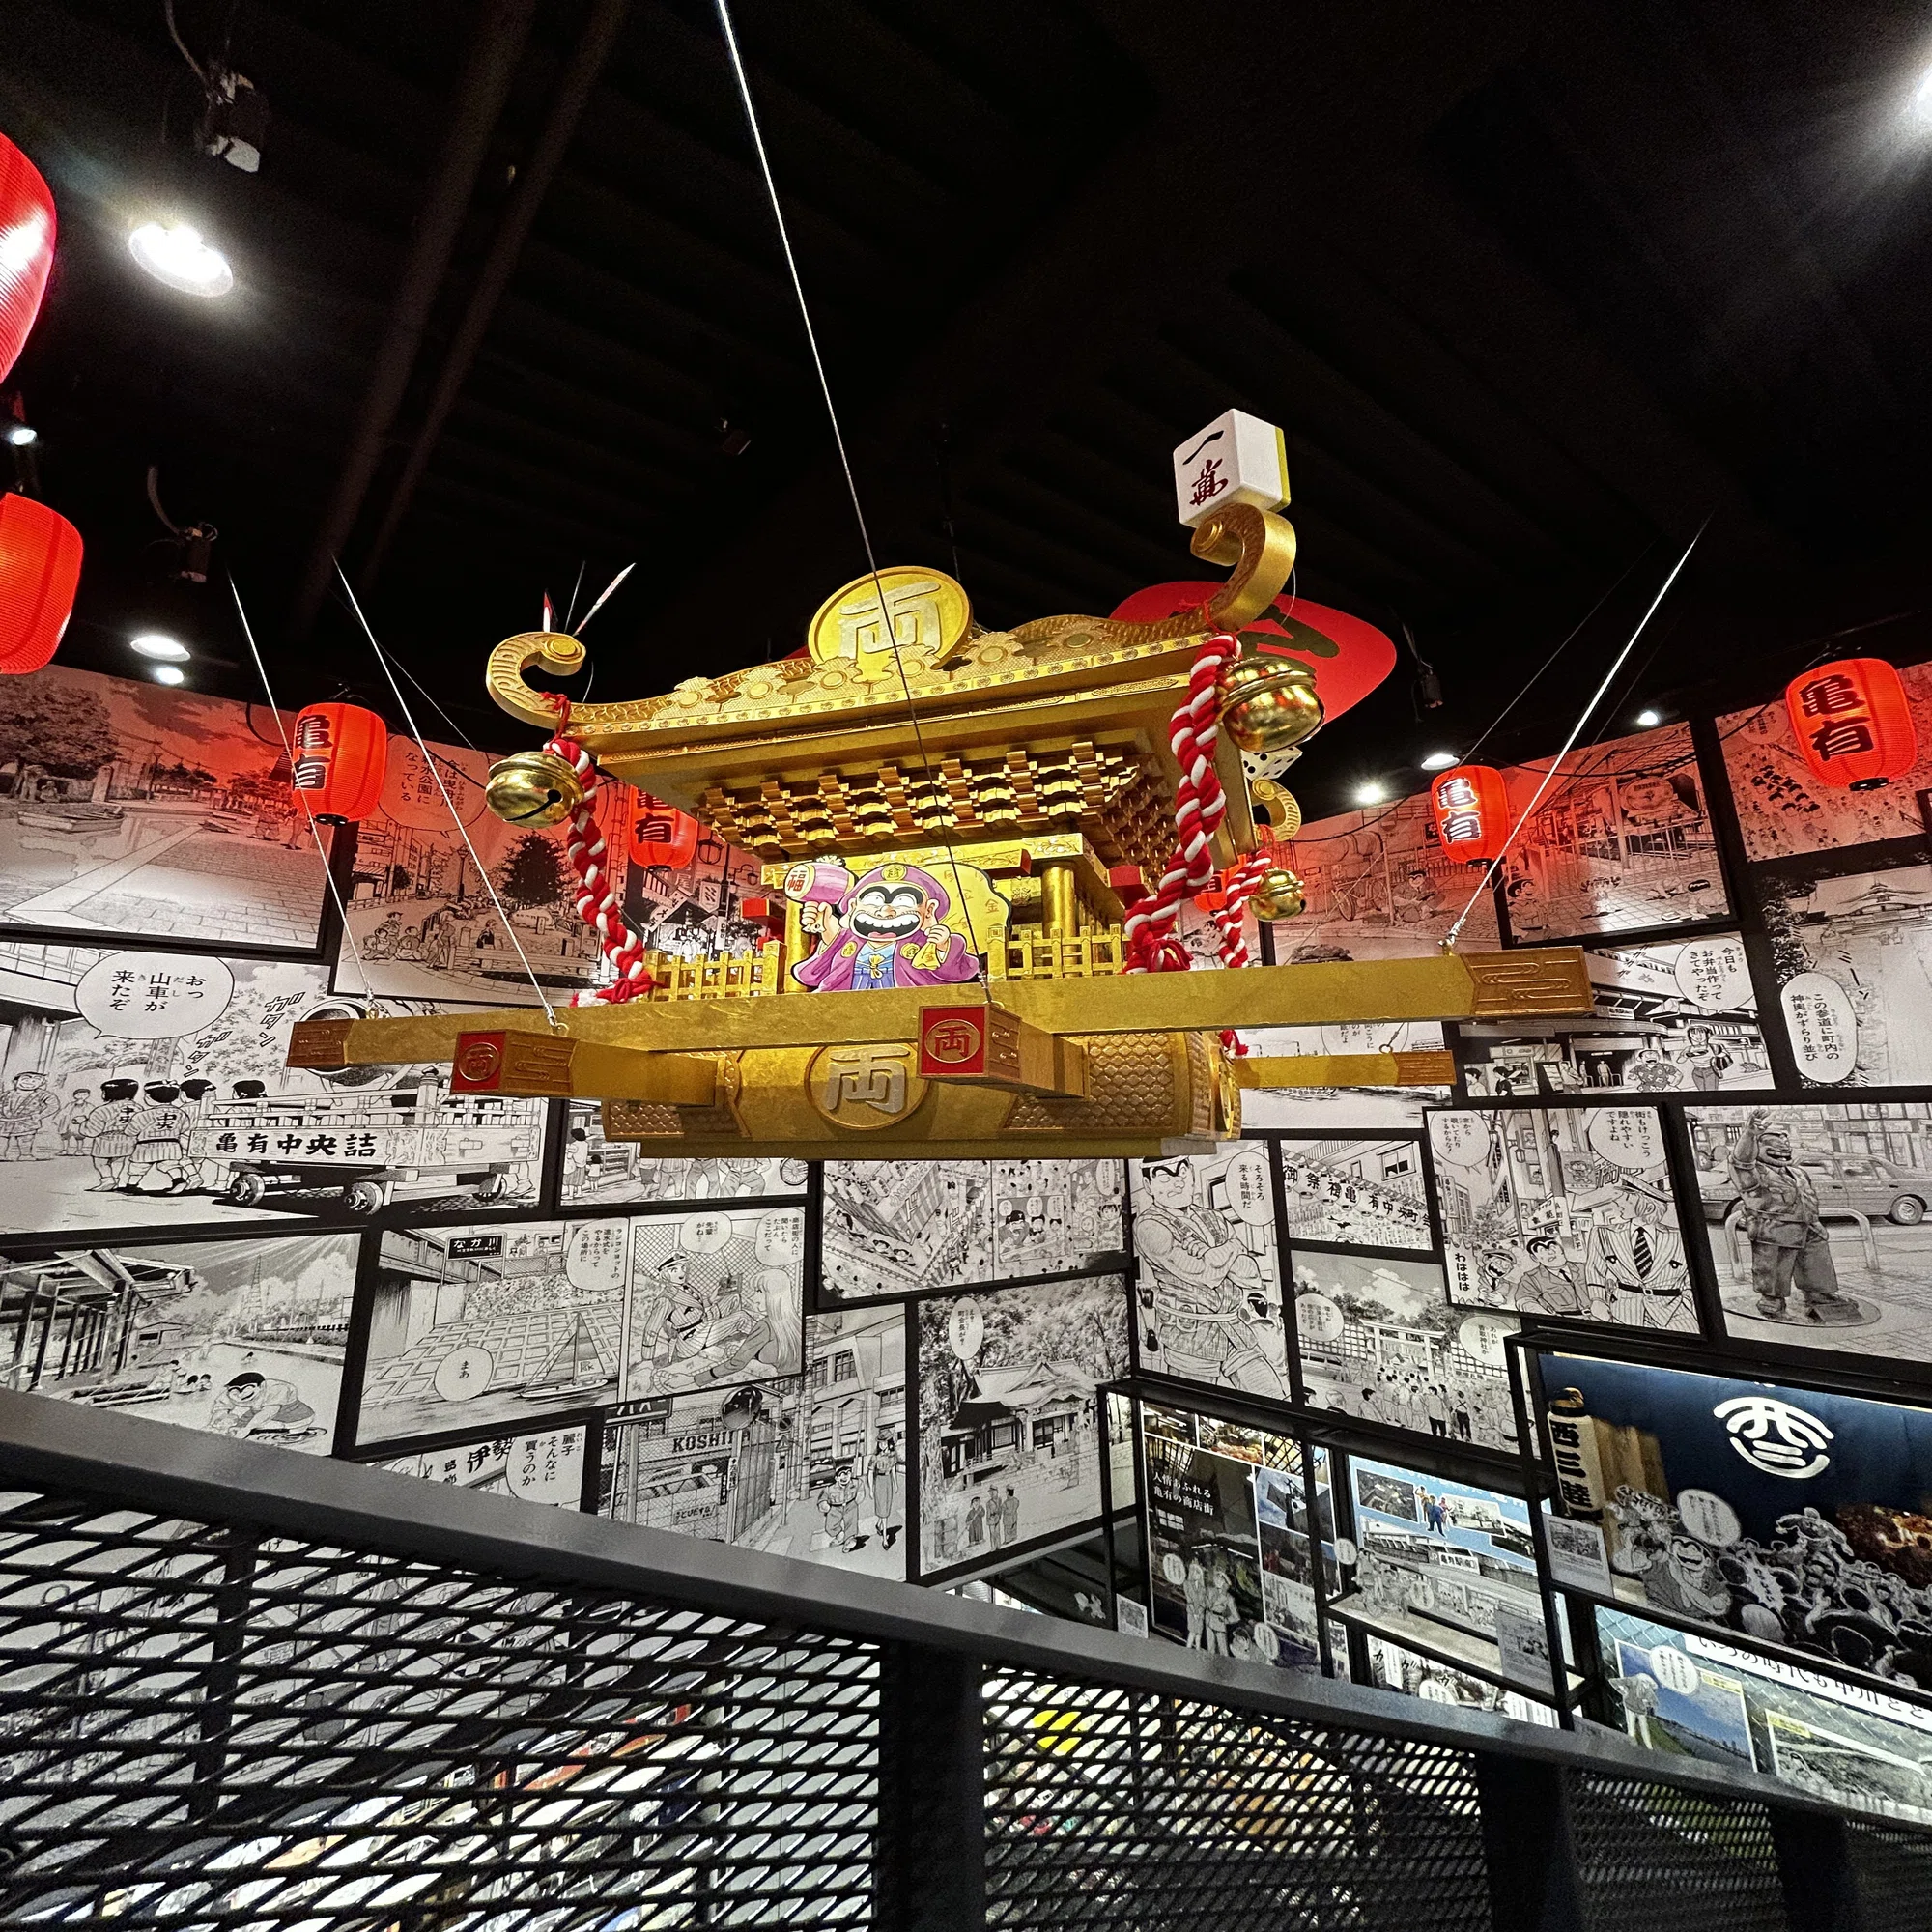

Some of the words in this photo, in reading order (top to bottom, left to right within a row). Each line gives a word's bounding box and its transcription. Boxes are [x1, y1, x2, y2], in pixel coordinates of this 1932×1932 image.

[1799, 673, 1874, 761] 亀有
[293, 714, 333, 791] 亀有
[401, 752, 419, 802] なっている
[1435, 778, 1483, 844] 亀有
[787, 870, 806, 892] 福
[1690, 952, 1710, 1001] きてやったぞ
[1702, 951, 1722, 1000] お弁当作って
[1721, 947, 1737, 973] 今日も
[109, 970, 135, 1011] 来たぞ
[144, 973, 171, 1012] 山車が
[186, 975, 206, 999] おっ
[259, 991, 306, 1047] ガタン
[1813, 993, 1839, 1060] この参道に町内の
[183, 1031, 233, 1077] ガタン
[934, 1025, 970, 1058] 両
[826, 1045, 911, 1113] 両
[215, 1132, 378, 1157] 亀有中央詰
[1605, 1111, 1620, 1142] ですよね
[1238, 1164, 1251, 1208] 来る時間だ
[1254, 1164, 1264, 1201] そろそろ
[763, 1218, 773, 1252] ここだって
[1455, 1253, 1470, 1292] わははは
[459, 1360, 469, 1379] まあ
[522, 1440, 537, 1487] 買うのか
[544, 1436, 559, 1482] そんなに
[561, 1433, 576, 1457] 麗子
[1152, 1472, 1211, 1499] 人情あふれる
[1154, 1486, 1214, 1516] 亀有の商店街
